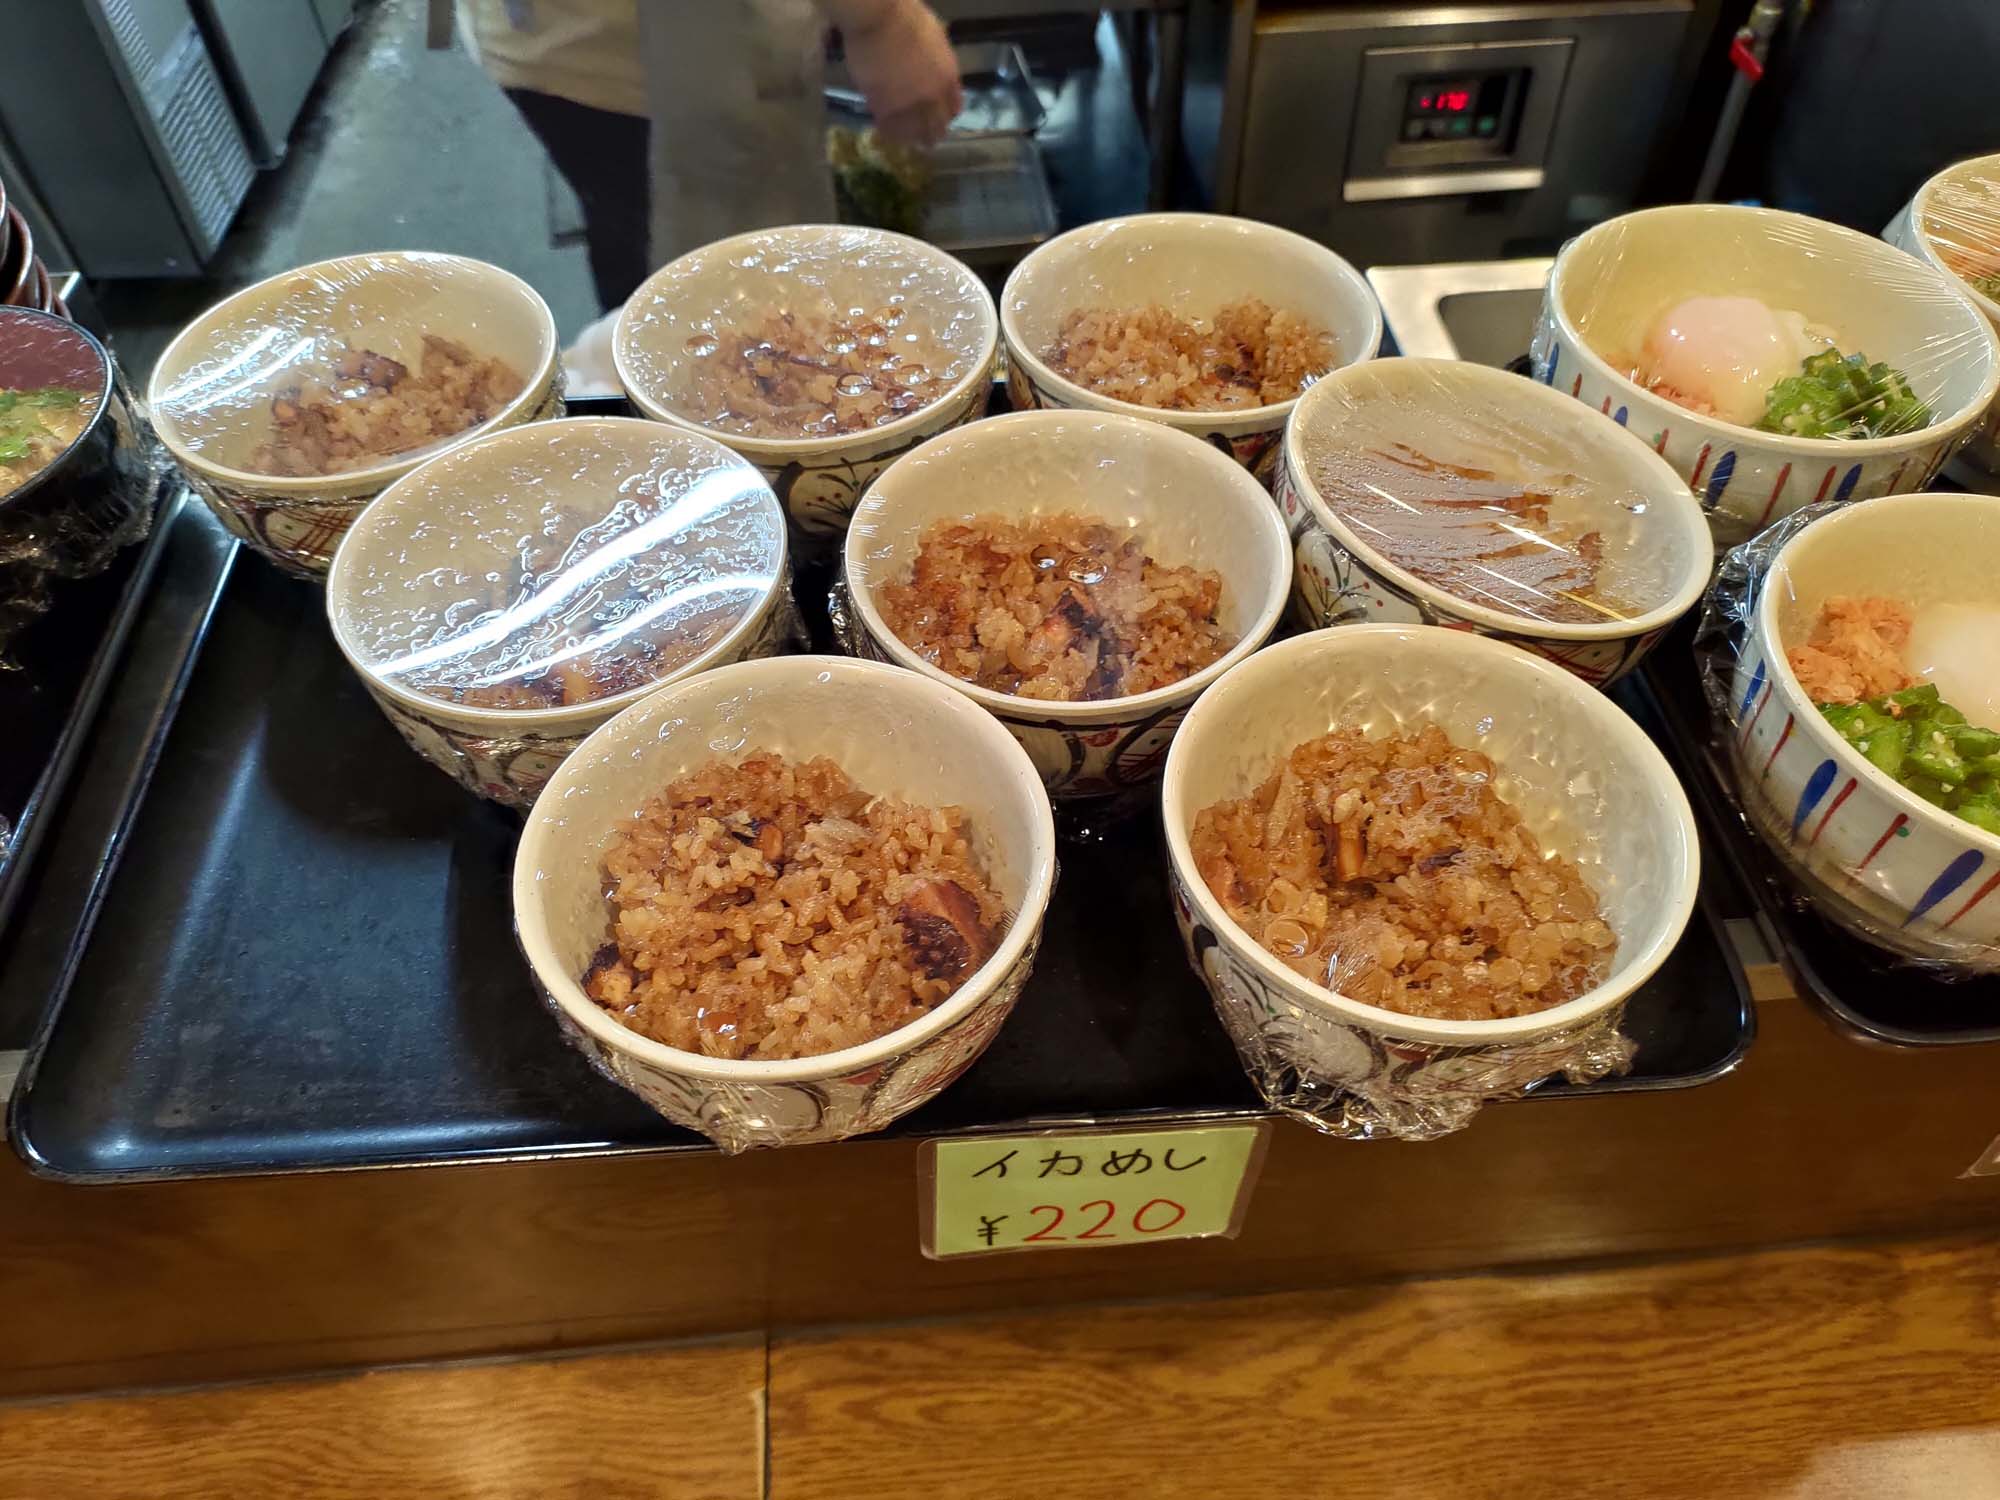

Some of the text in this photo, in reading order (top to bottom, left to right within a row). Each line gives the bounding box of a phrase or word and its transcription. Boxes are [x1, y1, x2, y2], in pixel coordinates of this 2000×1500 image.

[972, 1148, 1207, 1179] イカめし
[976, 1197, 1187, 1246] ¥220
